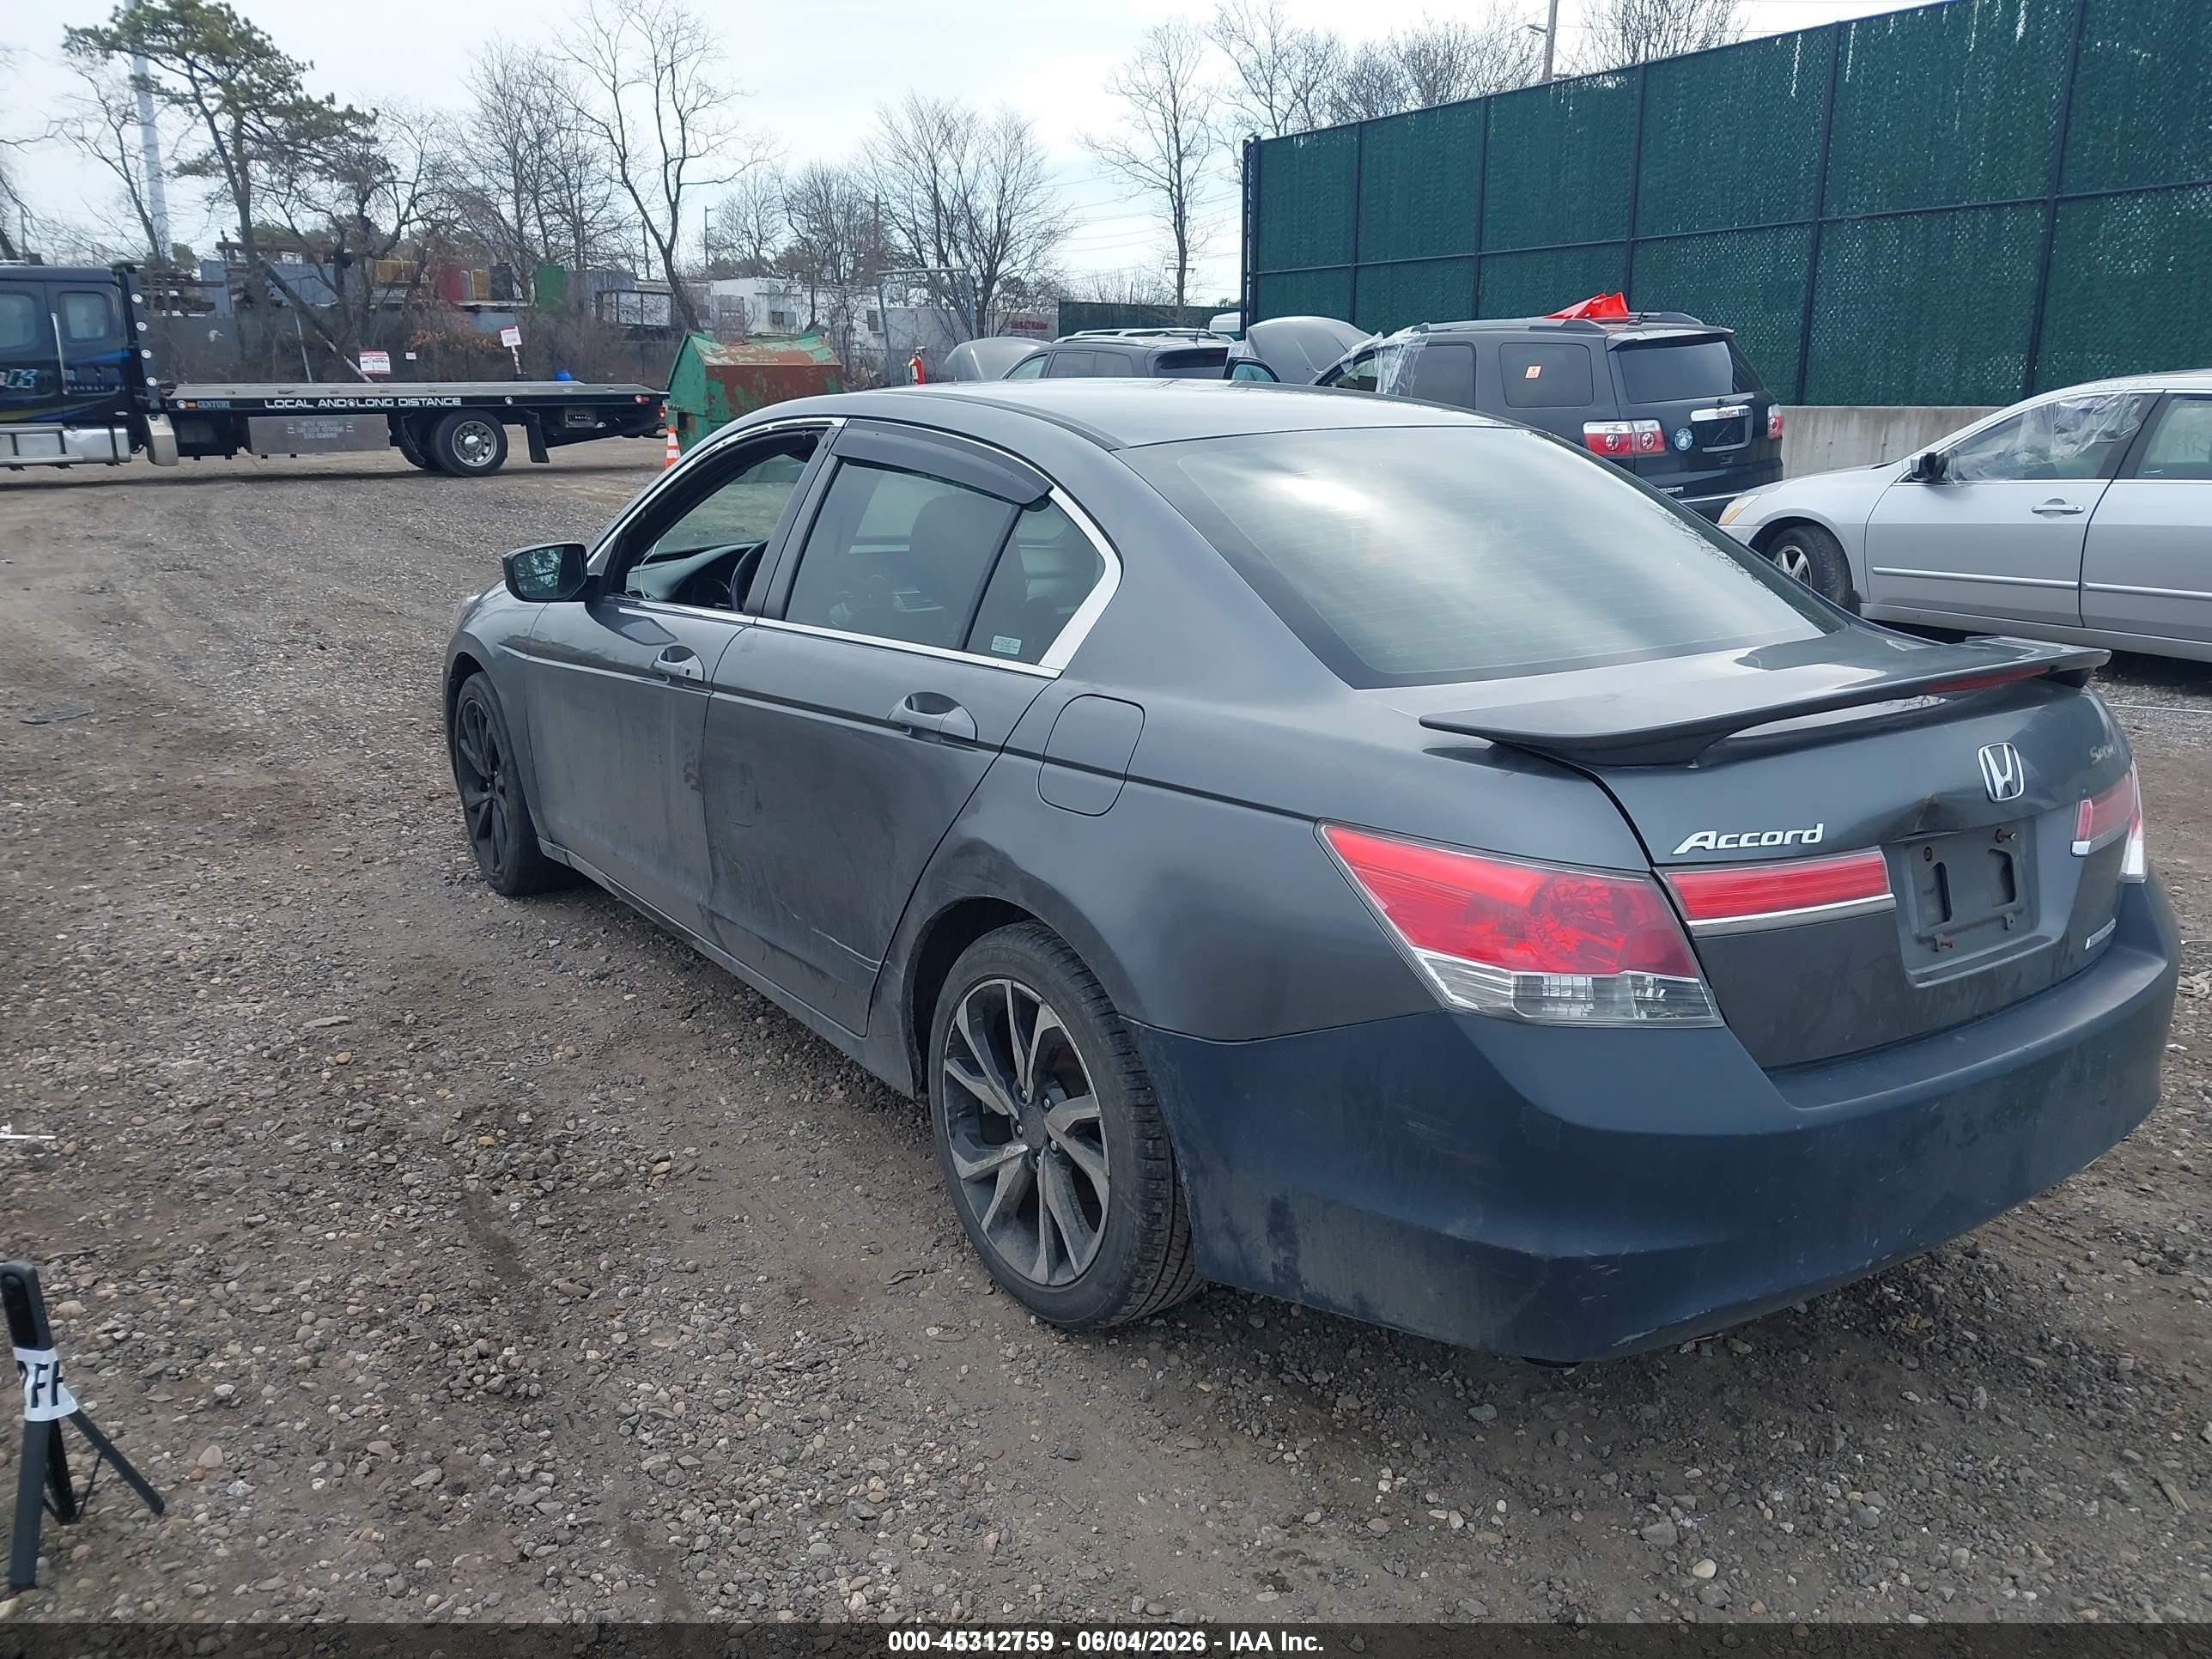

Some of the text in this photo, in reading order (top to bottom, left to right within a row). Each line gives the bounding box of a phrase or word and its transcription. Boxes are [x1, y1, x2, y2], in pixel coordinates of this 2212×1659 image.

[197, 400, 231, 409] CENTURY
[264, 398, 462, 409] LOCAL AND LONG DISTANCE
[1717, 409, 1739, 418] GMC
[1672, 823, 1825, 855] Accord
